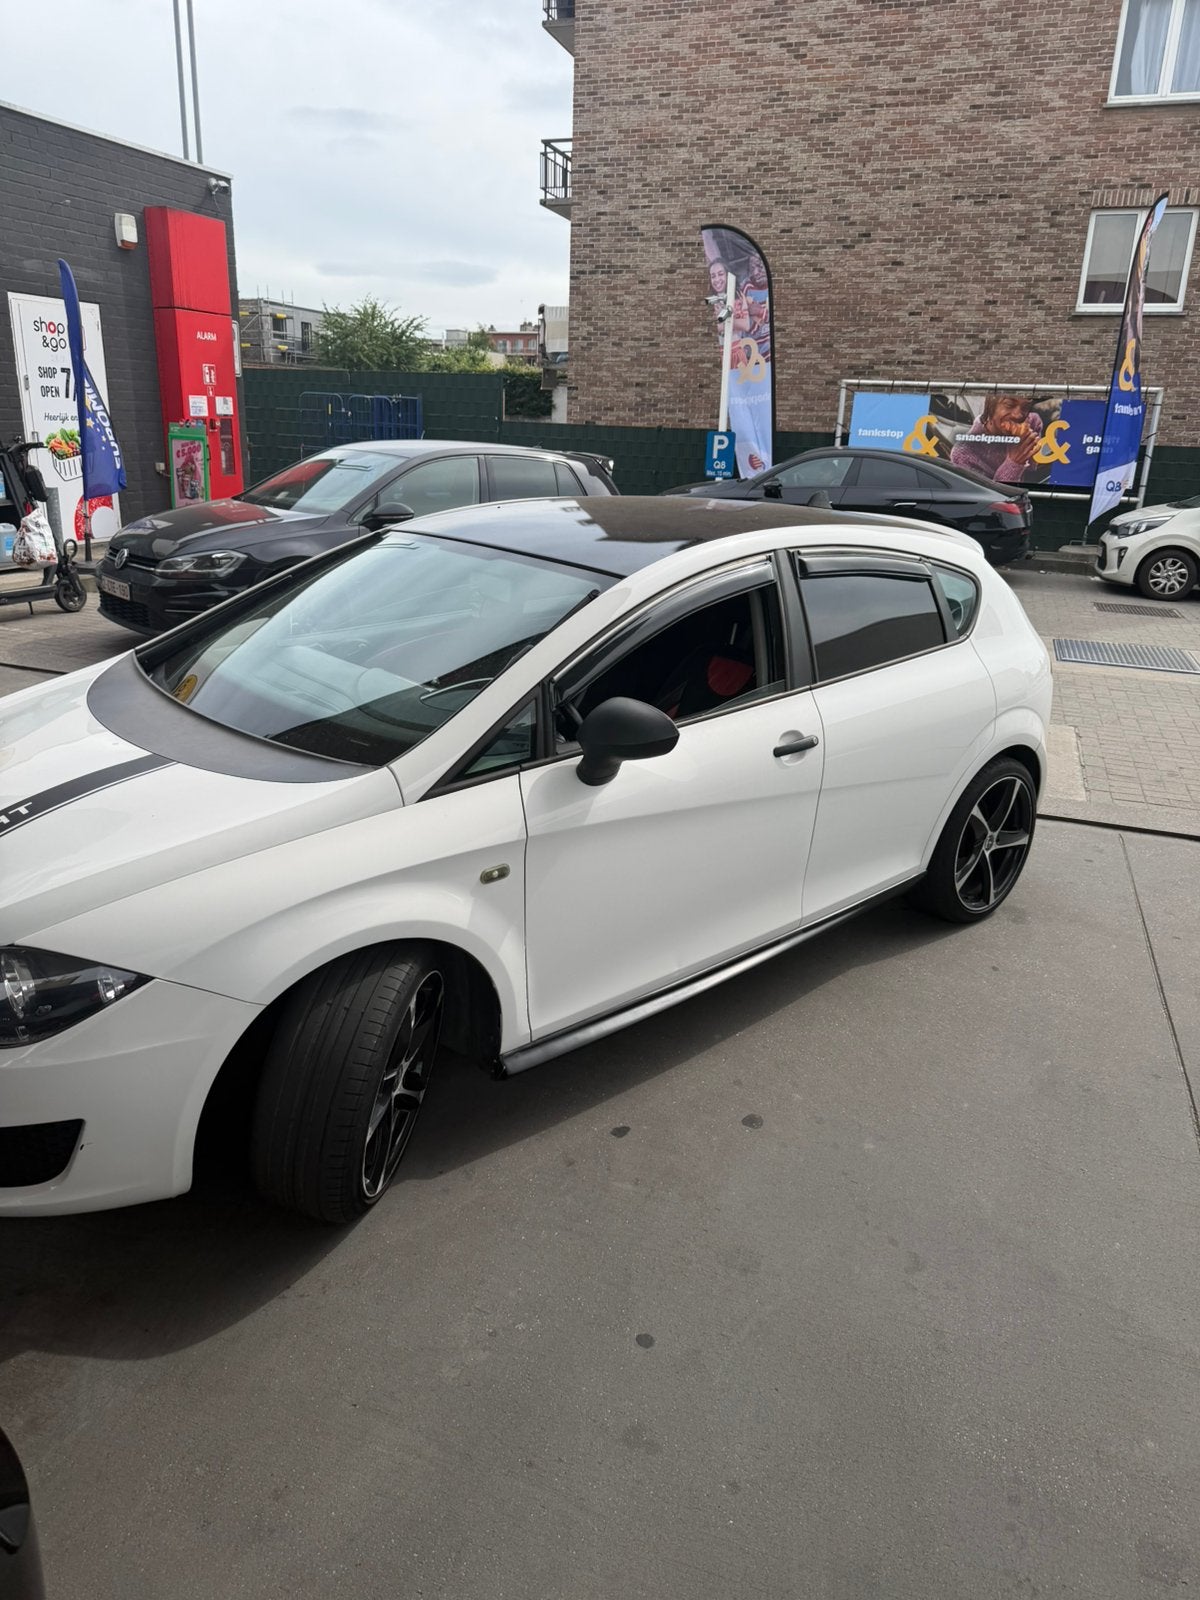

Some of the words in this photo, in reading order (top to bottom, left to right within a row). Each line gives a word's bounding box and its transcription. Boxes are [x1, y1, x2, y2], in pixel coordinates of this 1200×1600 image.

[33, 316, 65, 337] shop
[196, 331, 217, 341] ALARM
[42, 335, 67, 352] &go
[38, 366, 58, 379] SHOP
[40, 385, 60, 398] OPEN
[44, 412, 69, 424] Heerlijk
[858, 428, 904, 440] tankstop
[955, 433, 1021, 445] snackpauze
[1082, 433, 1094, 445] je
[712, 434, 729, 459] P
[713, 460, 726, 470] Q8
